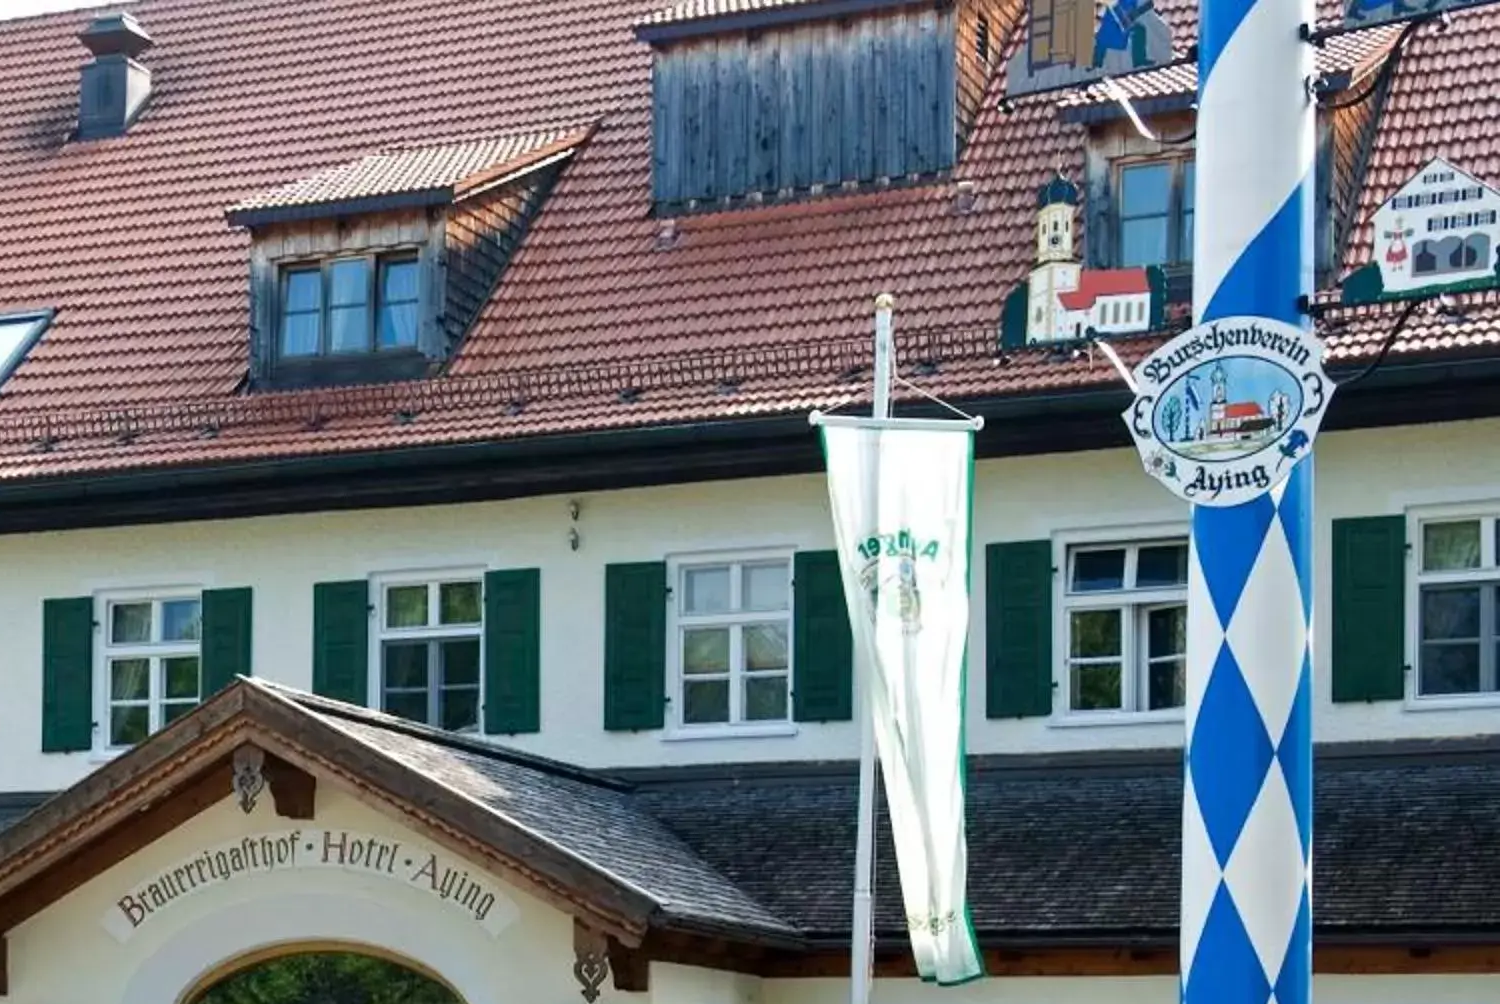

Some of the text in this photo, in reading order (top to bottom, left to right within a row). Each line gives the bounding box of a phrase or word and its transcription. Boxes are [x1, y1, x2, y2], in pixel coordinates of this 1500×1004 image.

[1143, 322, 1311, 384] Burschenverein
[1184, 464, 1270, 501] Aying
[321, 831, 401, 874] Hotel
[411, 853, 496, 921] Aying
